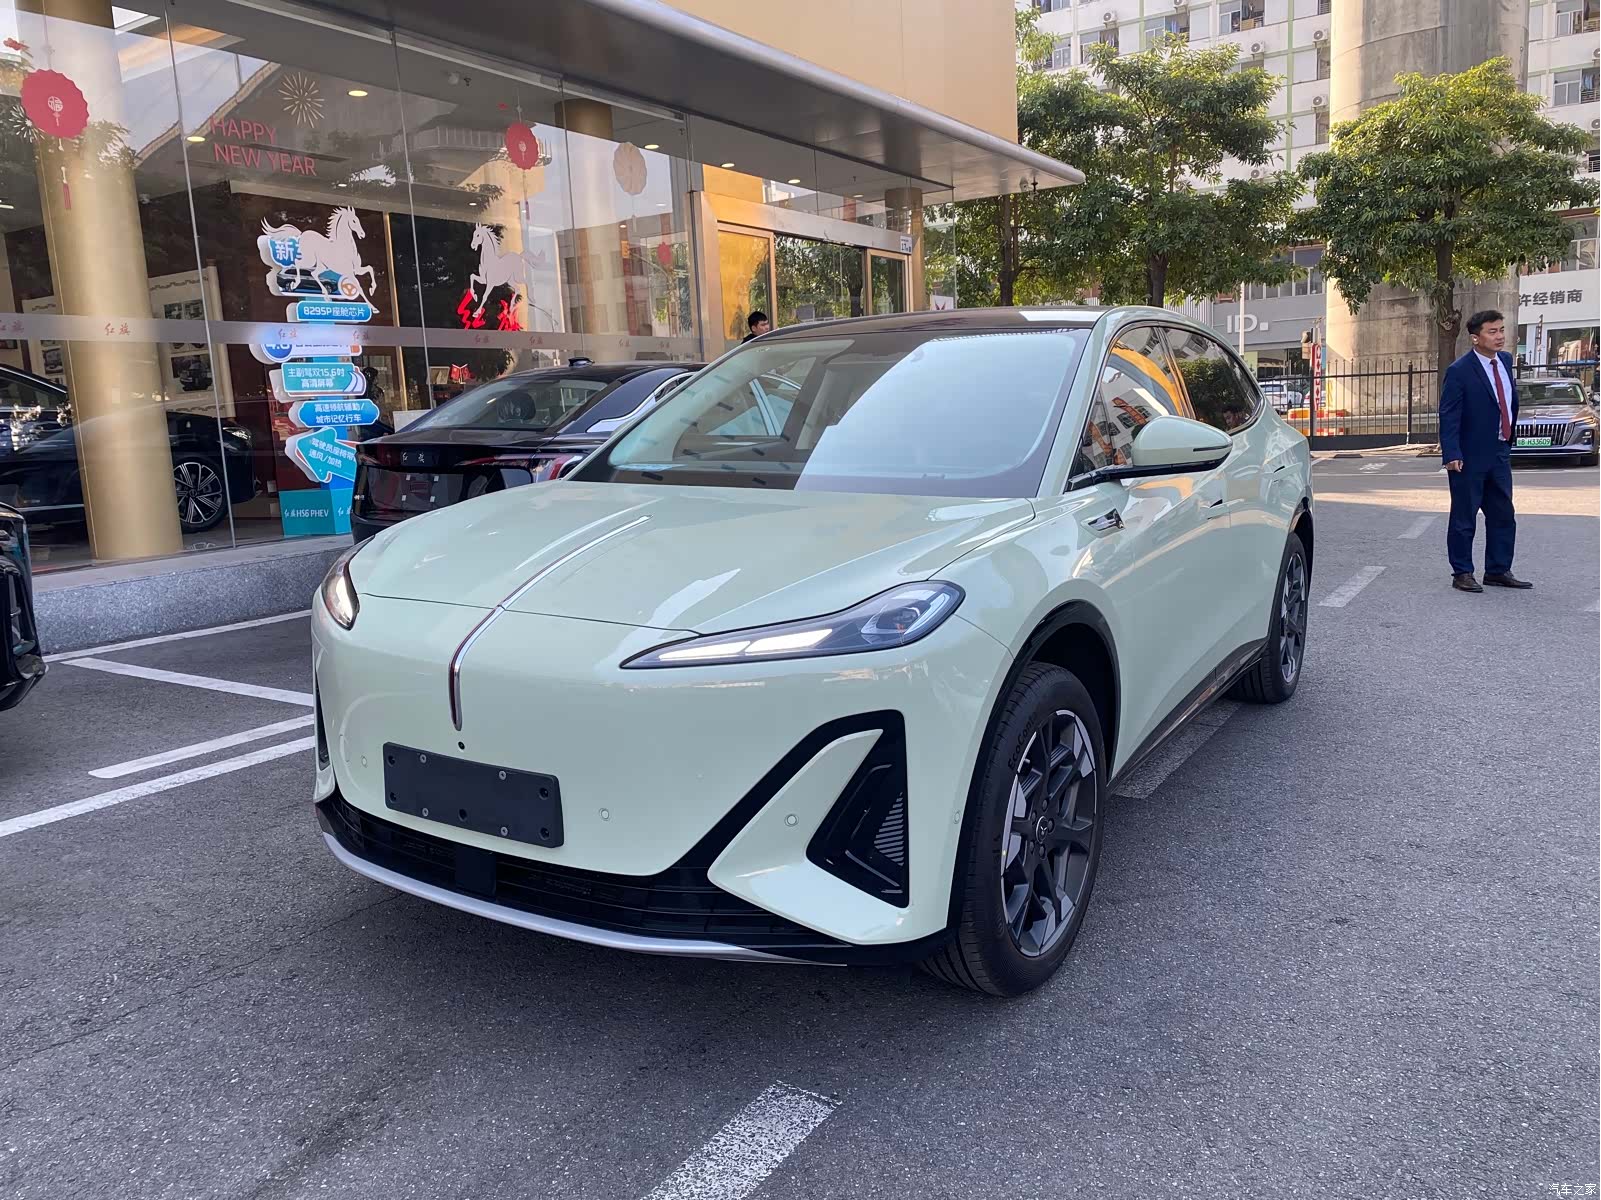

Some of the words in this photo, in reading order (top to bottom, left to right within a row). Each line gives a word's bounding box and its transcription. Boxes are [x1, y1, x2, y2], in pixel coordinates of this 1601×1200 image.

[210, 114, 276, 145] HAPPY
[214, 143, 260, 169] NEW
[265, 150, 317, 176] YEAR
[315, 414, 362, 424] 城市记忆行车
[310, 509, 329, 518] PHEV
